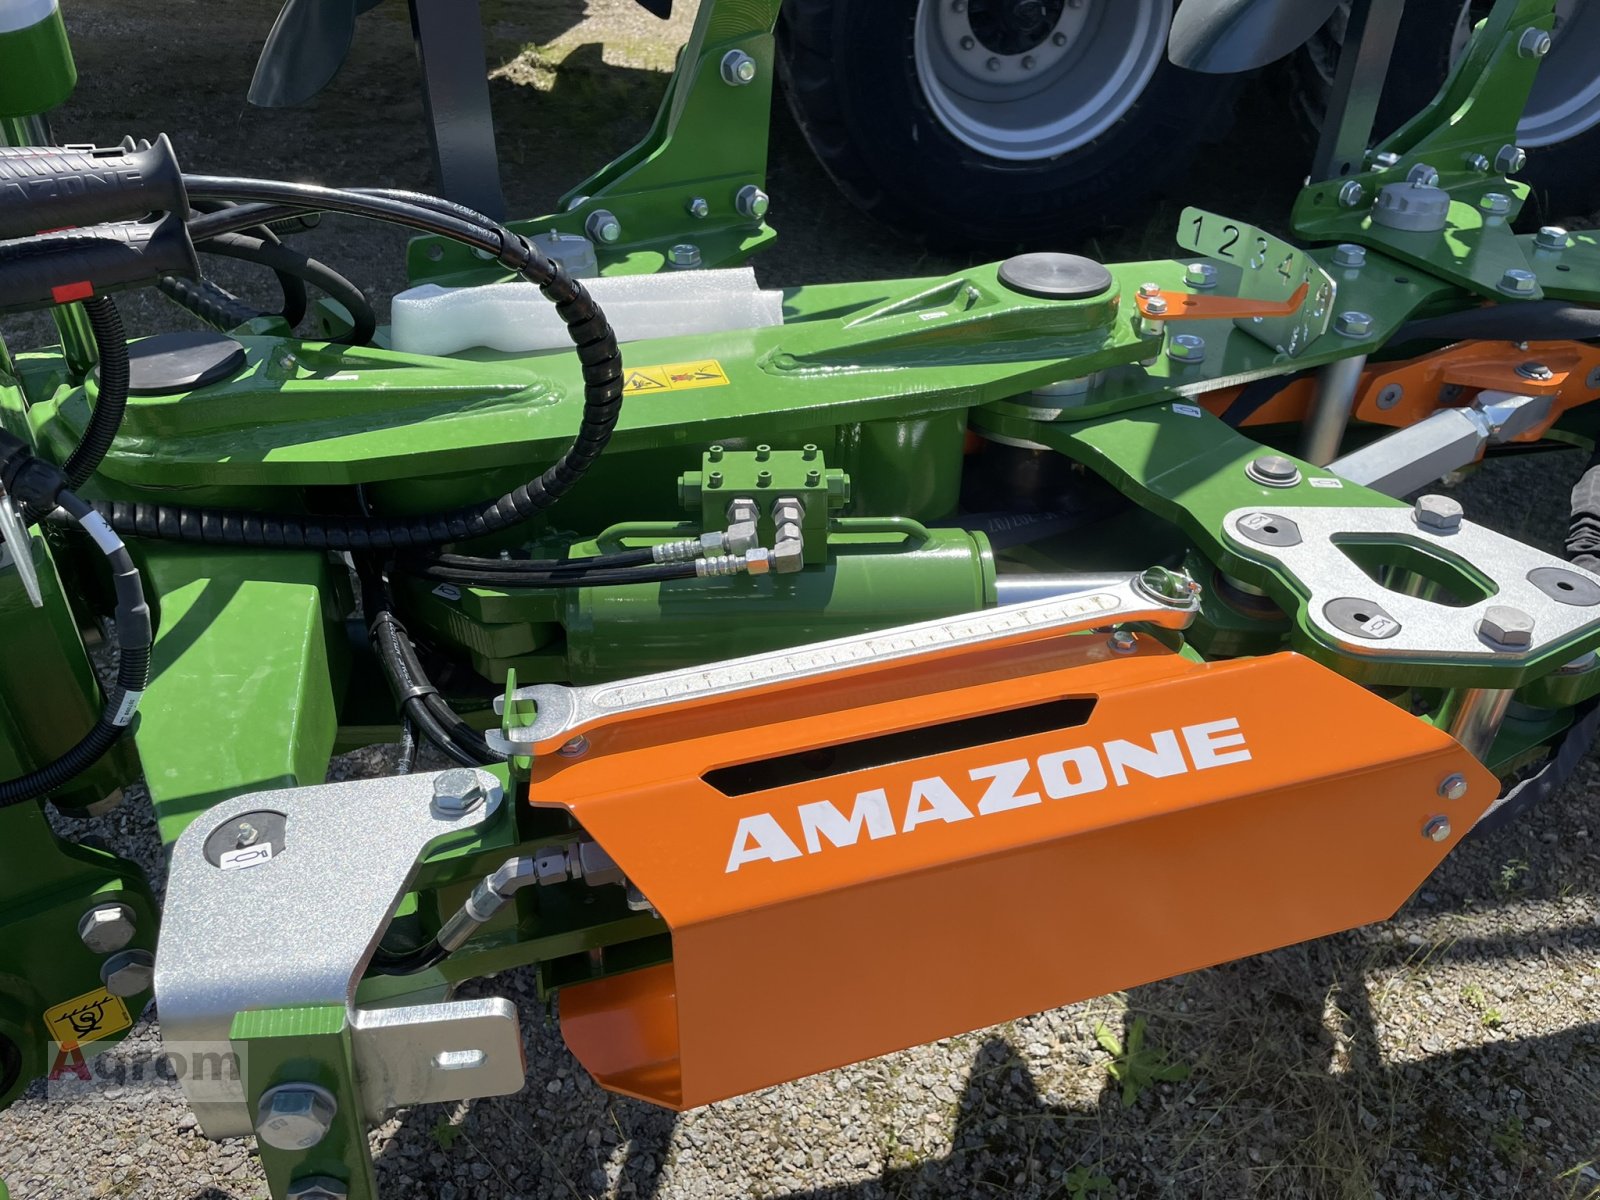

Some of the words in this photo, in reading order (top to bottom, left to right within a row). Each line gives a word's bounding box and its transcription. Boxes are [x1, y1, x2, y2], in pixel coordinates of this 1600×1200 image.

[1193, 216, 1204, 247] 1
[1218, 225, 1240, 259] 2
[1250, 237, 1268, 271] 3
[1277, 252, 1294, 286] 4
[724, 717, 1252, 873] AMAZONE
